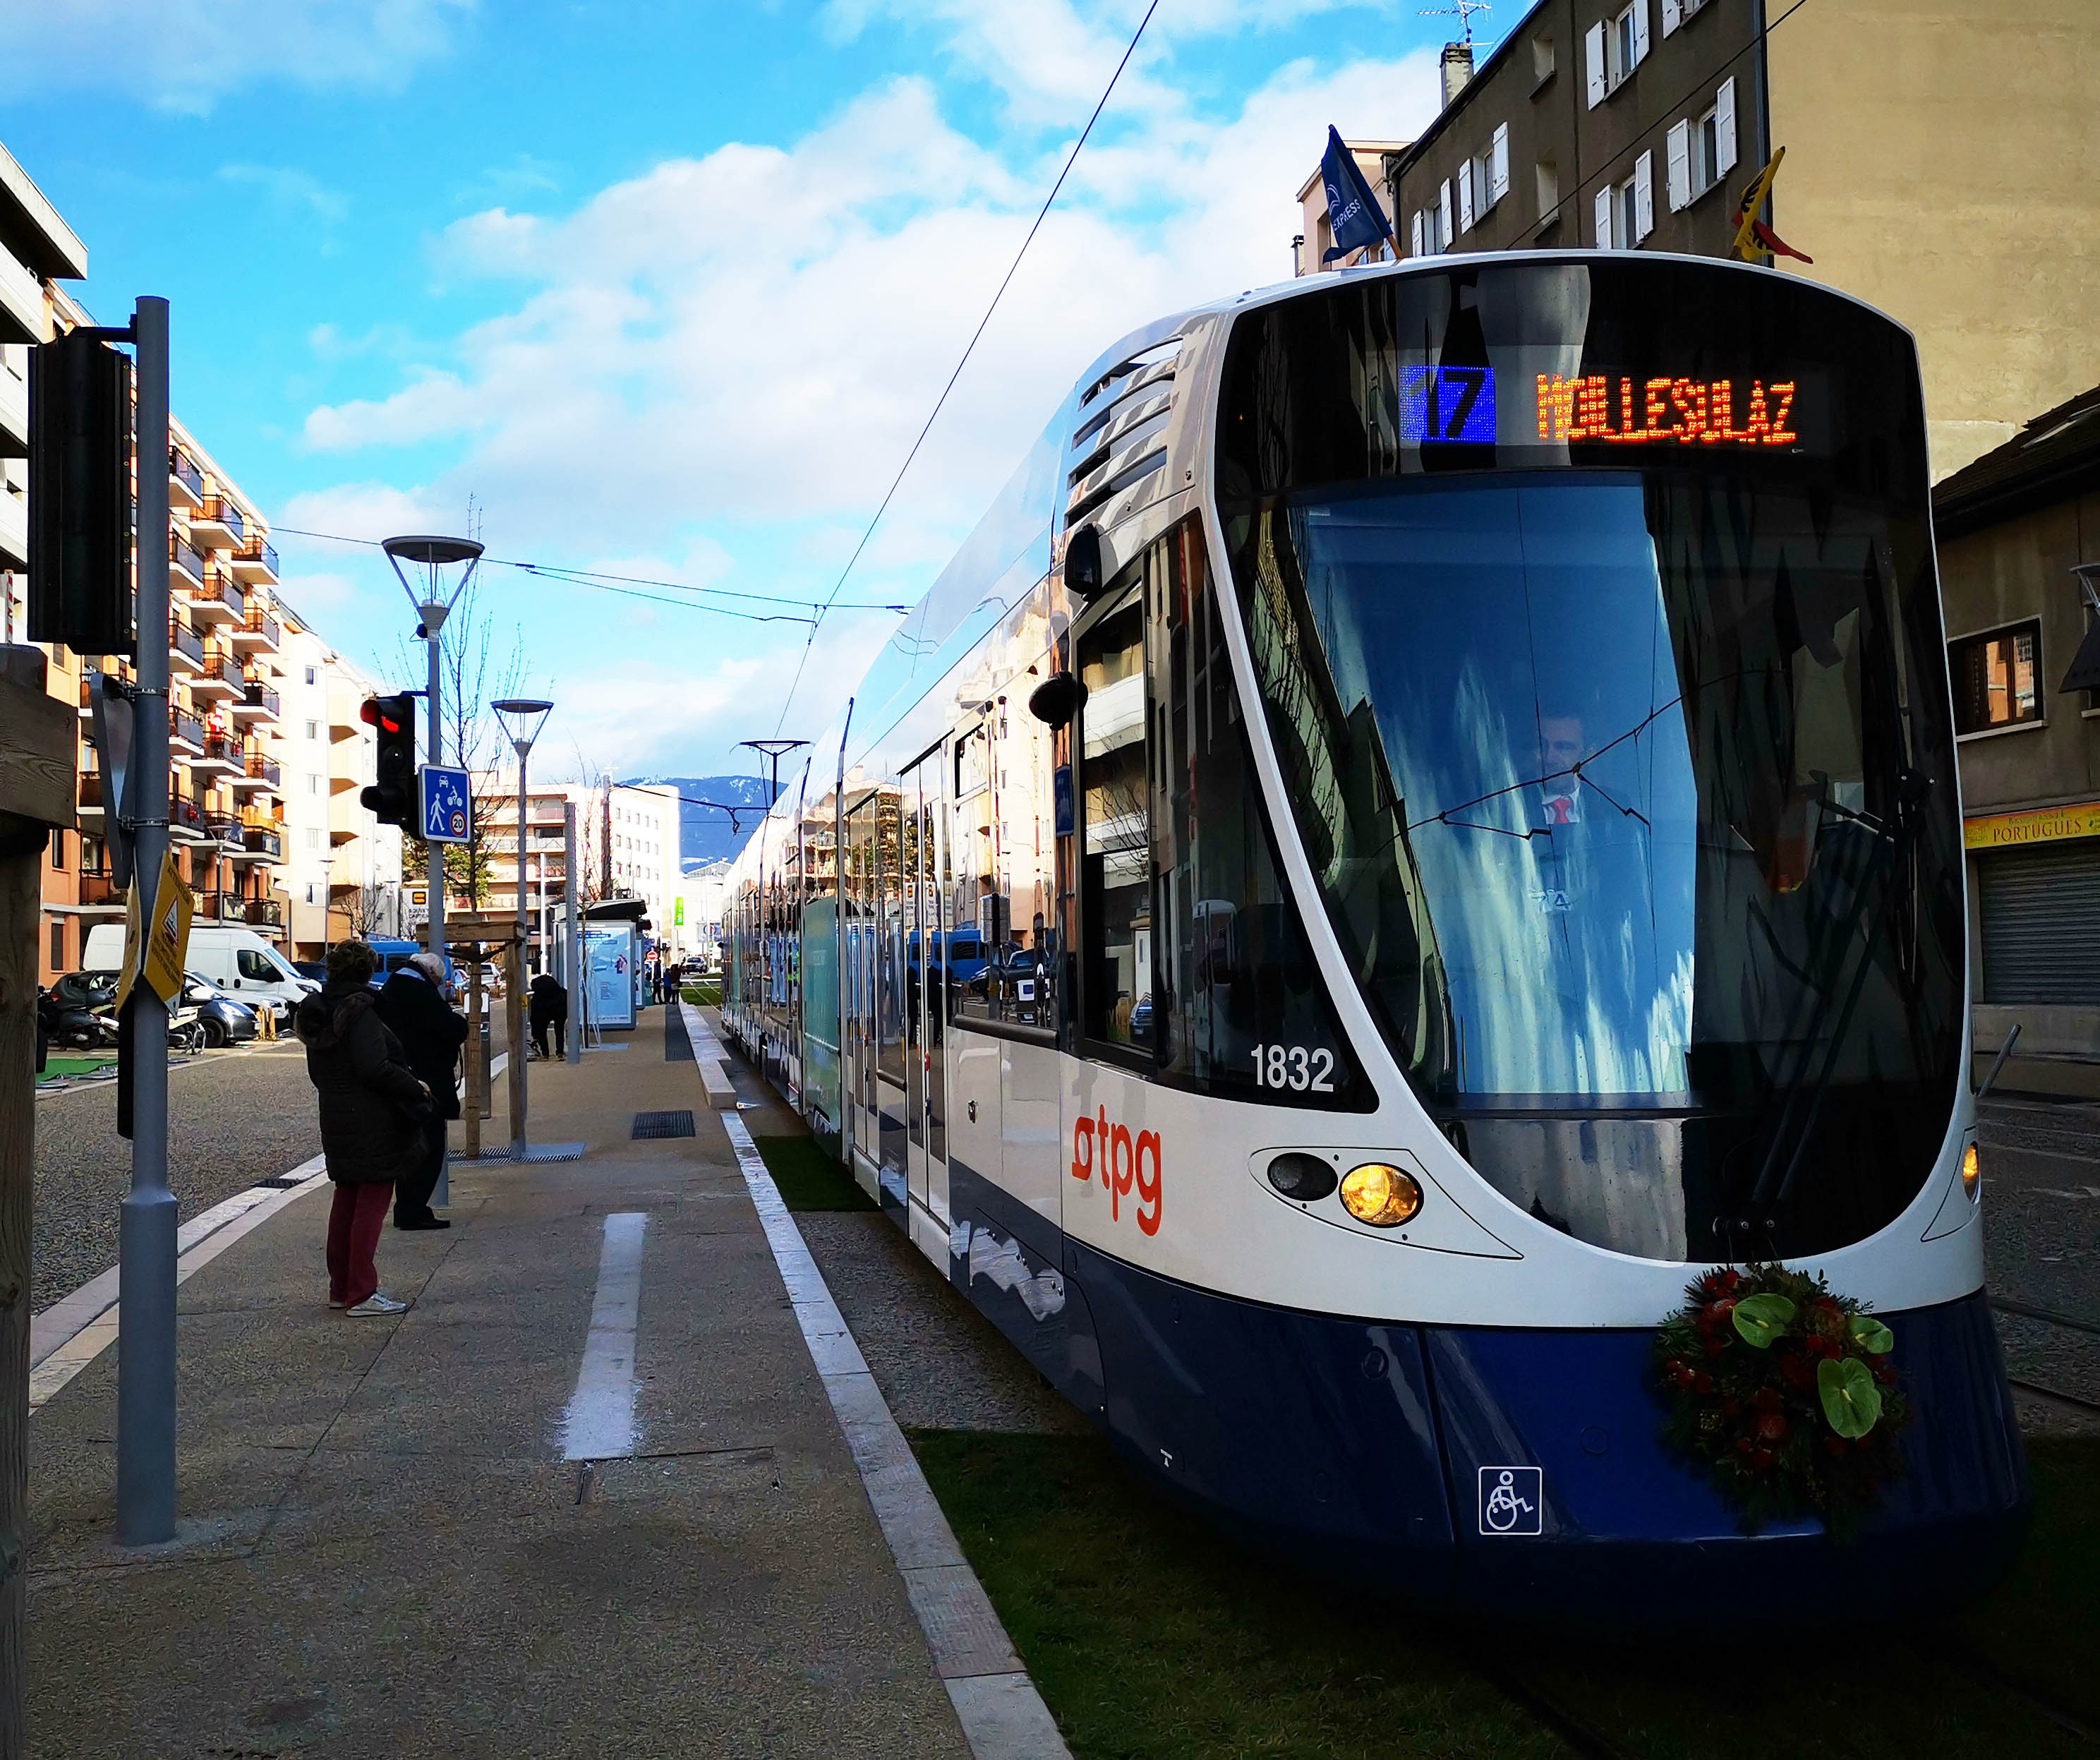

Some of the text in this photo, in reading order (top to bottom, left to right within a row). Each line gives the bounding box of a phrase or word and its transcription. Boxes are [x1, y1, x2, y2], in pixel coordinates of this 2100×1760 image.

[1332, 198, 1360, 231] EXPRESS
[1408, 369, 1485, 438] 17
[452, 819, 463, 829] 20
[1250, 1044, 1334, 1092] 1832
